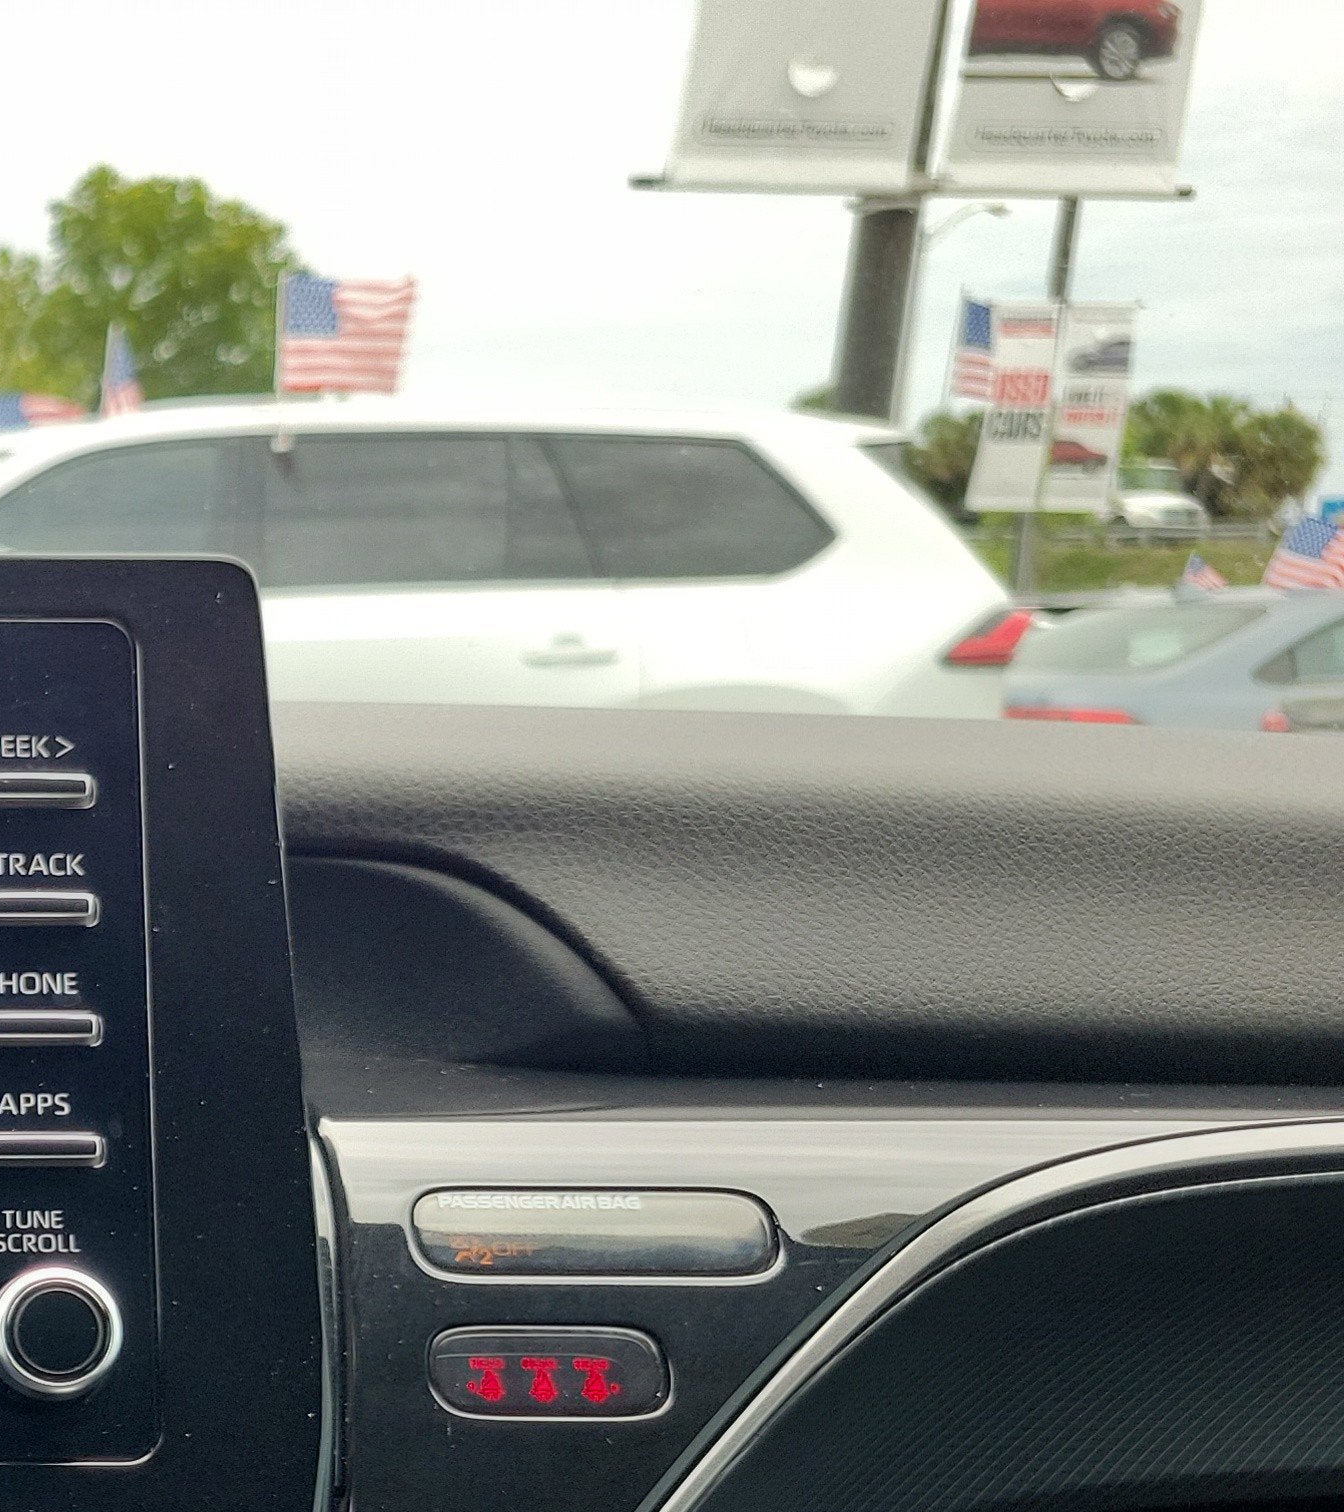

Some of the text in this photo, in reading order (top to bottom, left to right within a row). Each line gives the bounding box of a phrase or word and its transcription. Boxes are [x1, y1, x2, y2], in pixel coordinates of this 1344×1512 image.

[439, 1194, 642, 1210] PASSENGER AIR BAG
[2, 1209, 65, 1229] TUNE
